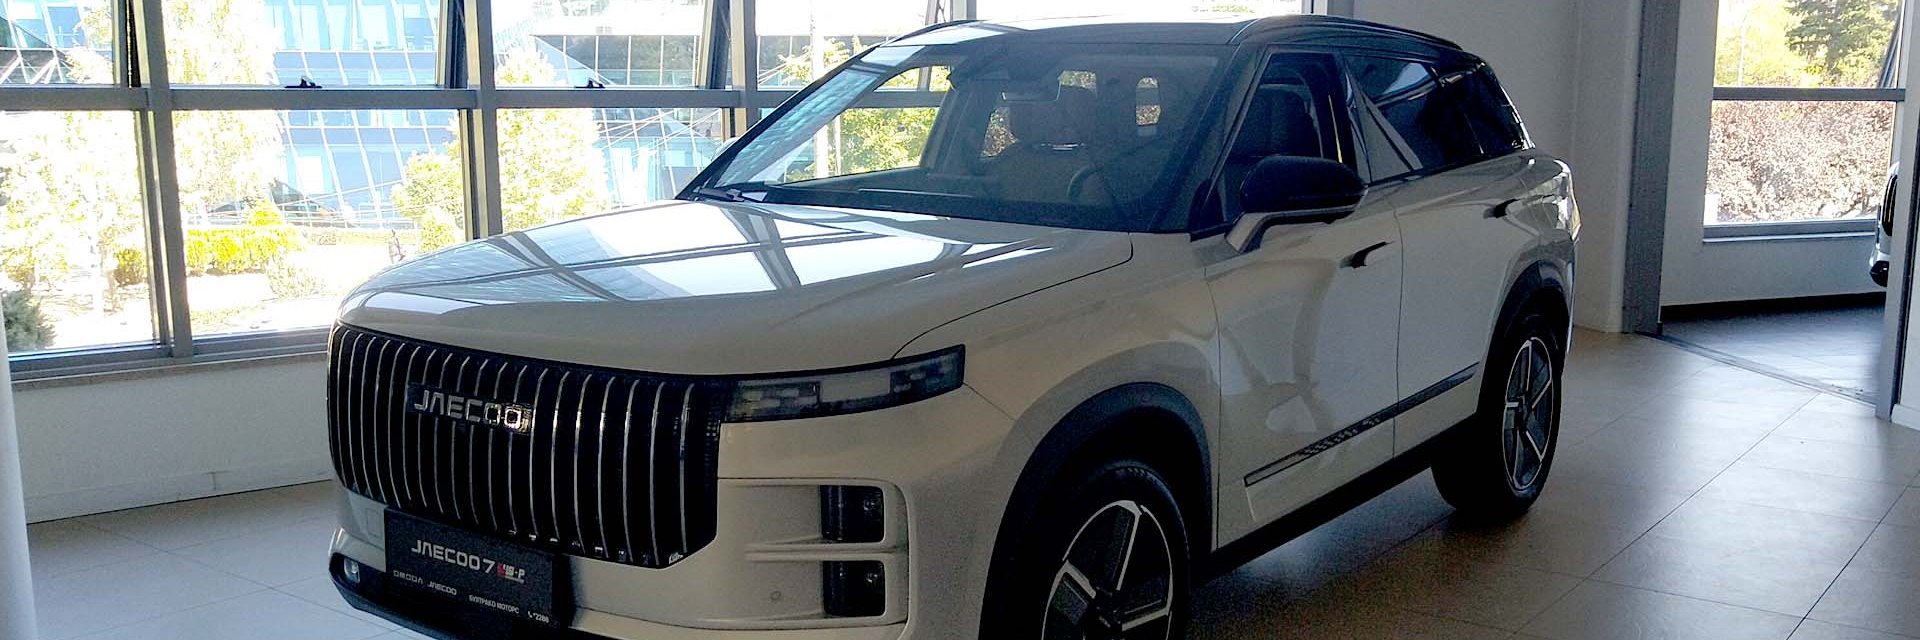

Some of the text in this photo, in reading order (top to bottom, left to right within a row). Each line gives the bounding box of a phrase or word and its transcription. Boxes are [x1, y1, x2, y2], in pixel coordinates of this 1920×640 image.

[414, 390, 522, 430] JAECOO
[411, 540, 480, 571] JAECOO
[483, 558, 495, 573] 7
[428, 581, 457, 596] JAECOO
